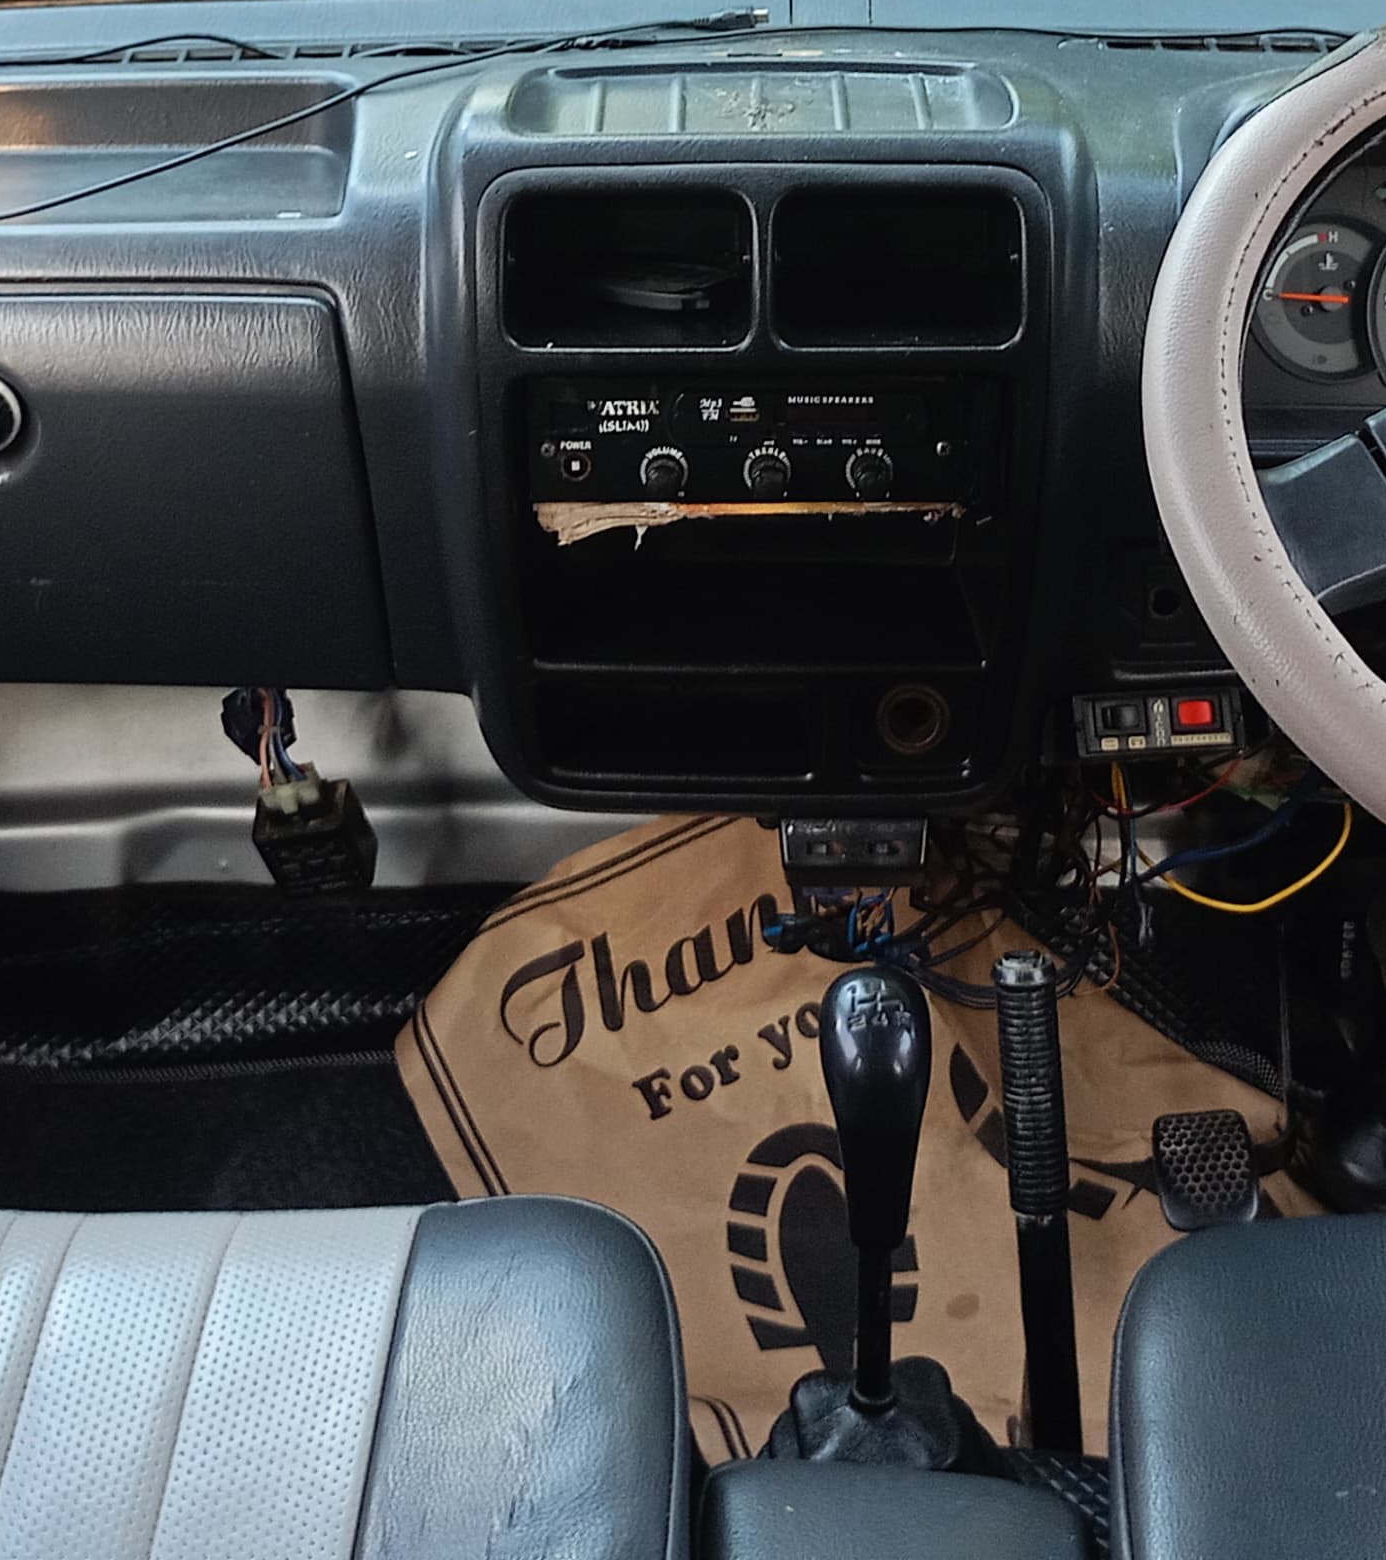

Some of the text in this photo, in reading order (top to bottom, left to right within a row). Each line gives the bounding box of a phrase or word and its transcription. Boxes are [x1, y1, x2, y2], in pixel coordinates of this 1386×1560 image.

[1328, 231, 1339, 243] H
[560, 441, 592, 450] POWER
[501, 893, 778, 1068] Than
[632, 1002, 822, 1120] For yo
